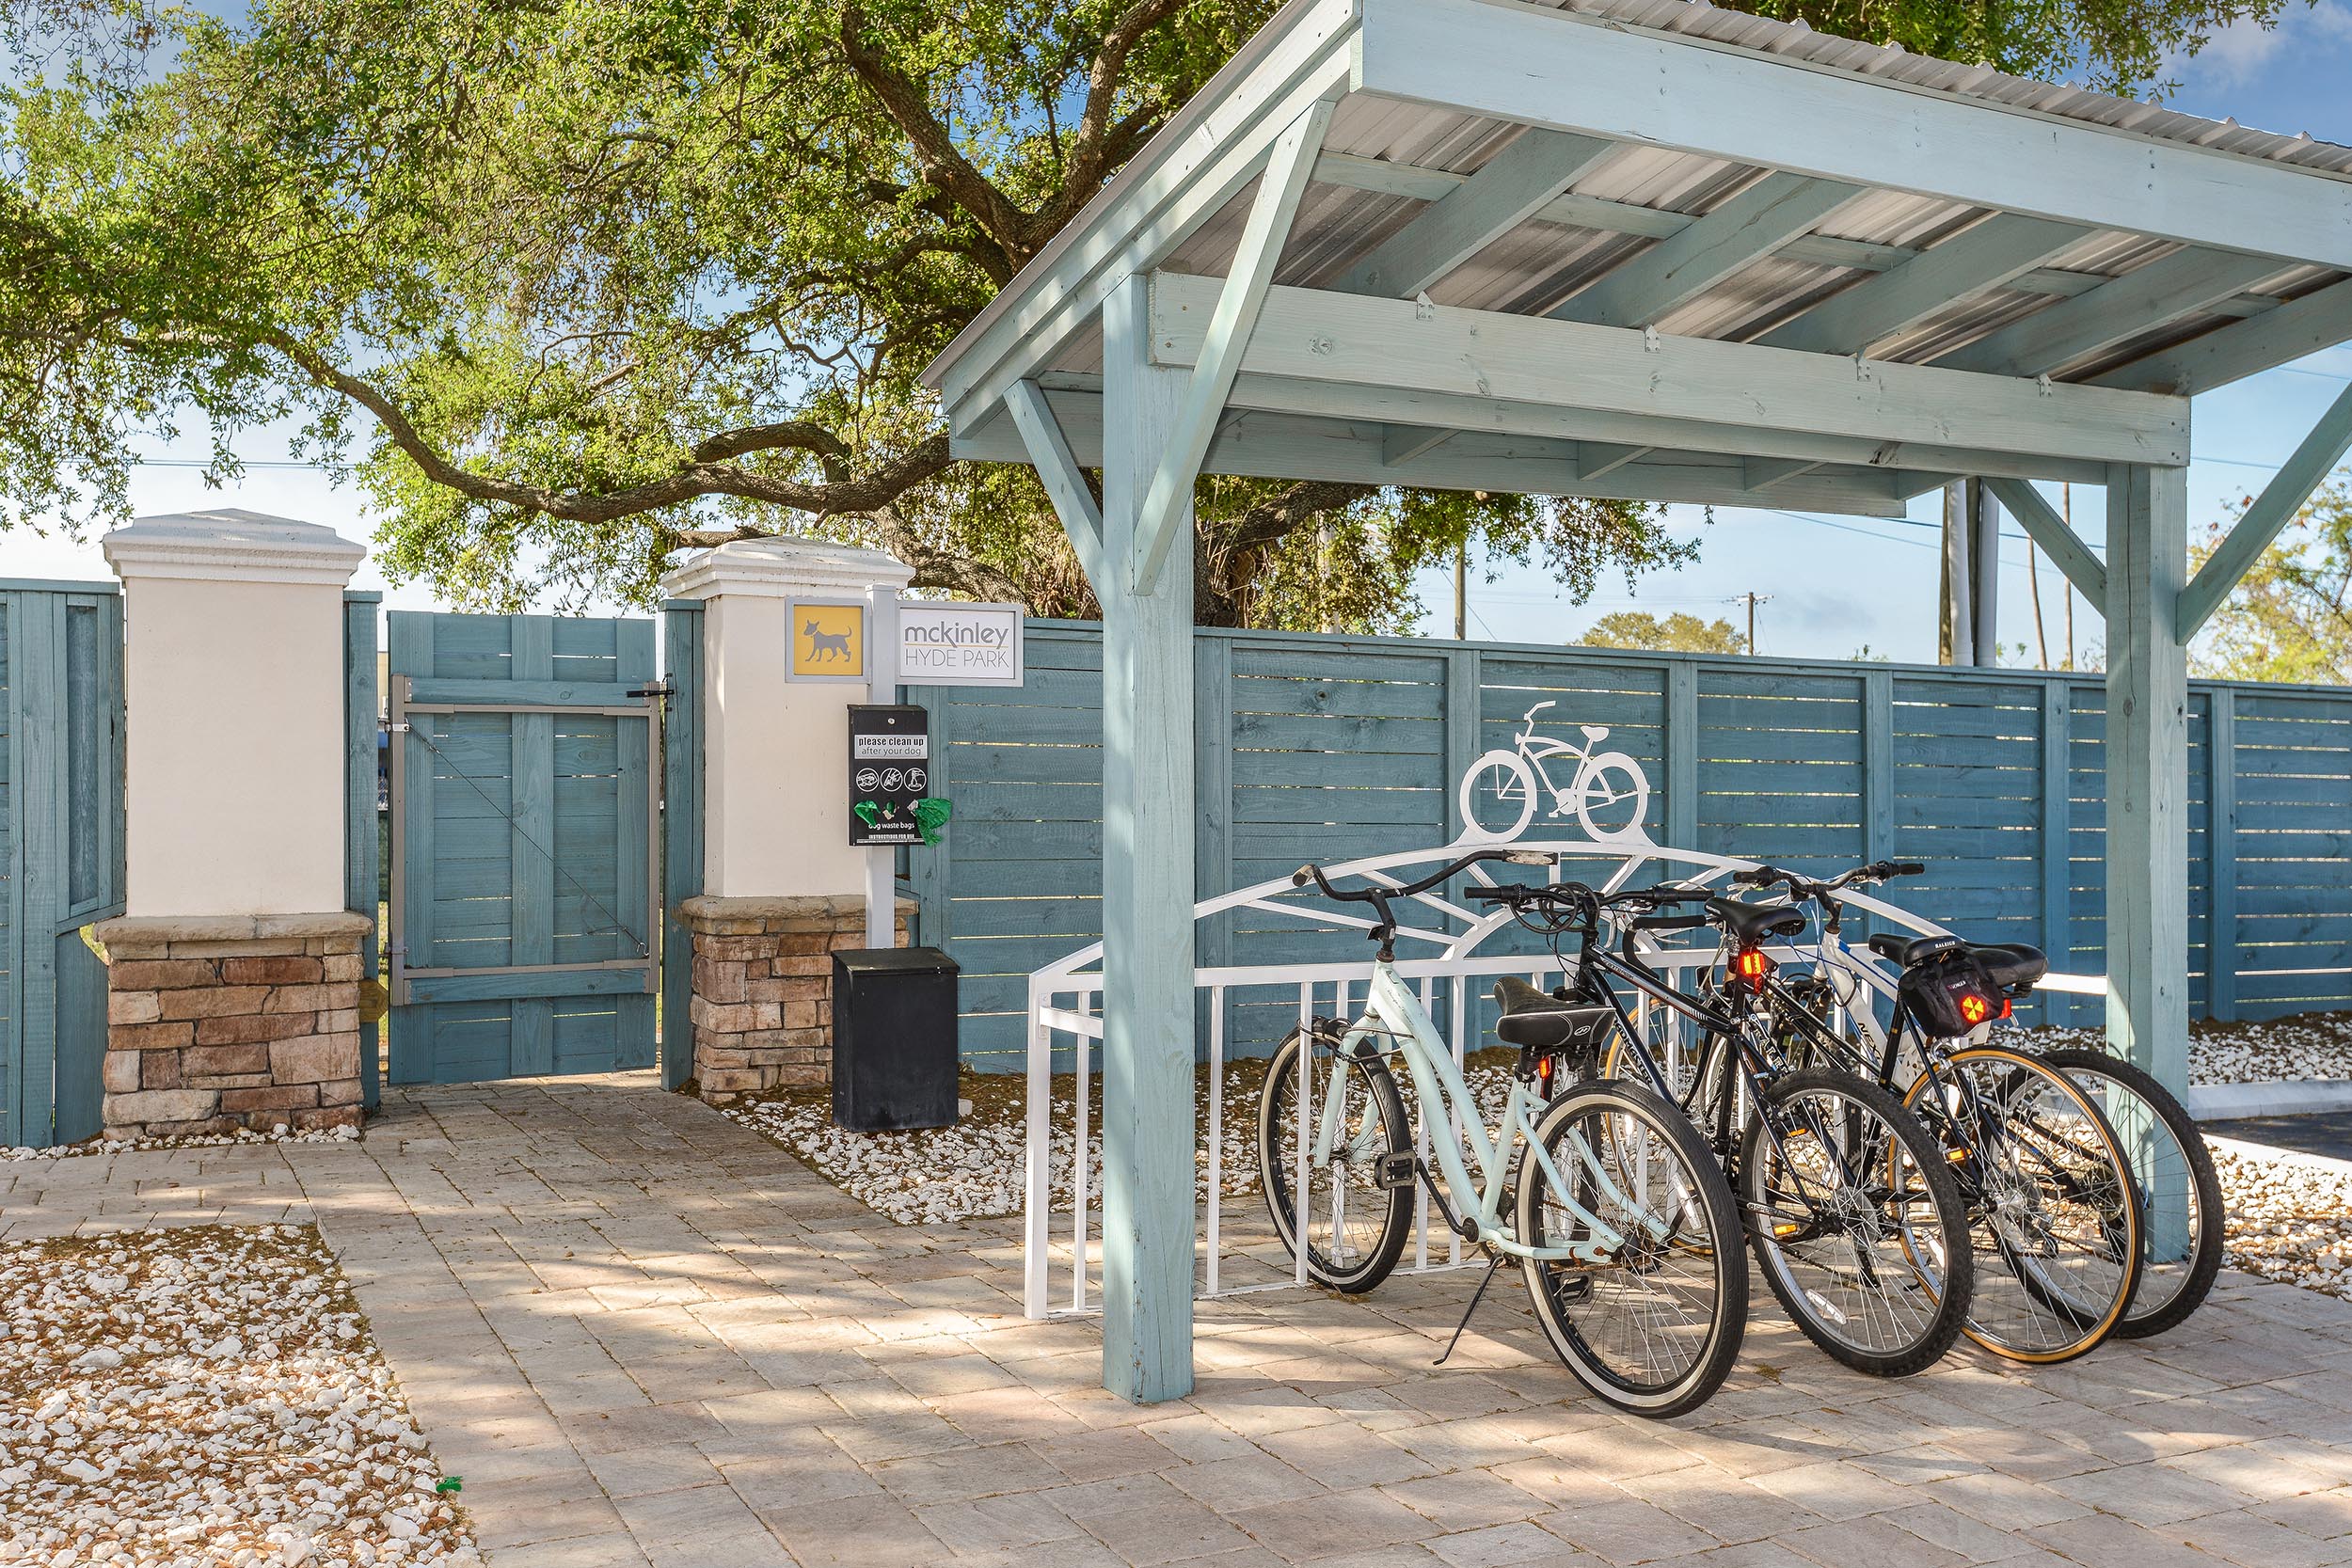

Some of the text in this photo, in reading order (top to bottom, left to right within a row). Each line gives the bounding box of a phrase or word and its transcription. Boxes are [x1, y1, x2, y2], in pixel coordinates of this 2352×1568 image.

[904, 621, 1009, 649] mckinley
[905, 648, 1009, 668] HYDE PARK
[858, 737, 886, 746] please
[888, 737, 912, 746] clean
[861, 746, 921, 756] after your dog
[900, 821, 914, 830] bags
[1934, 941, 1956, 949] RALEIGH
